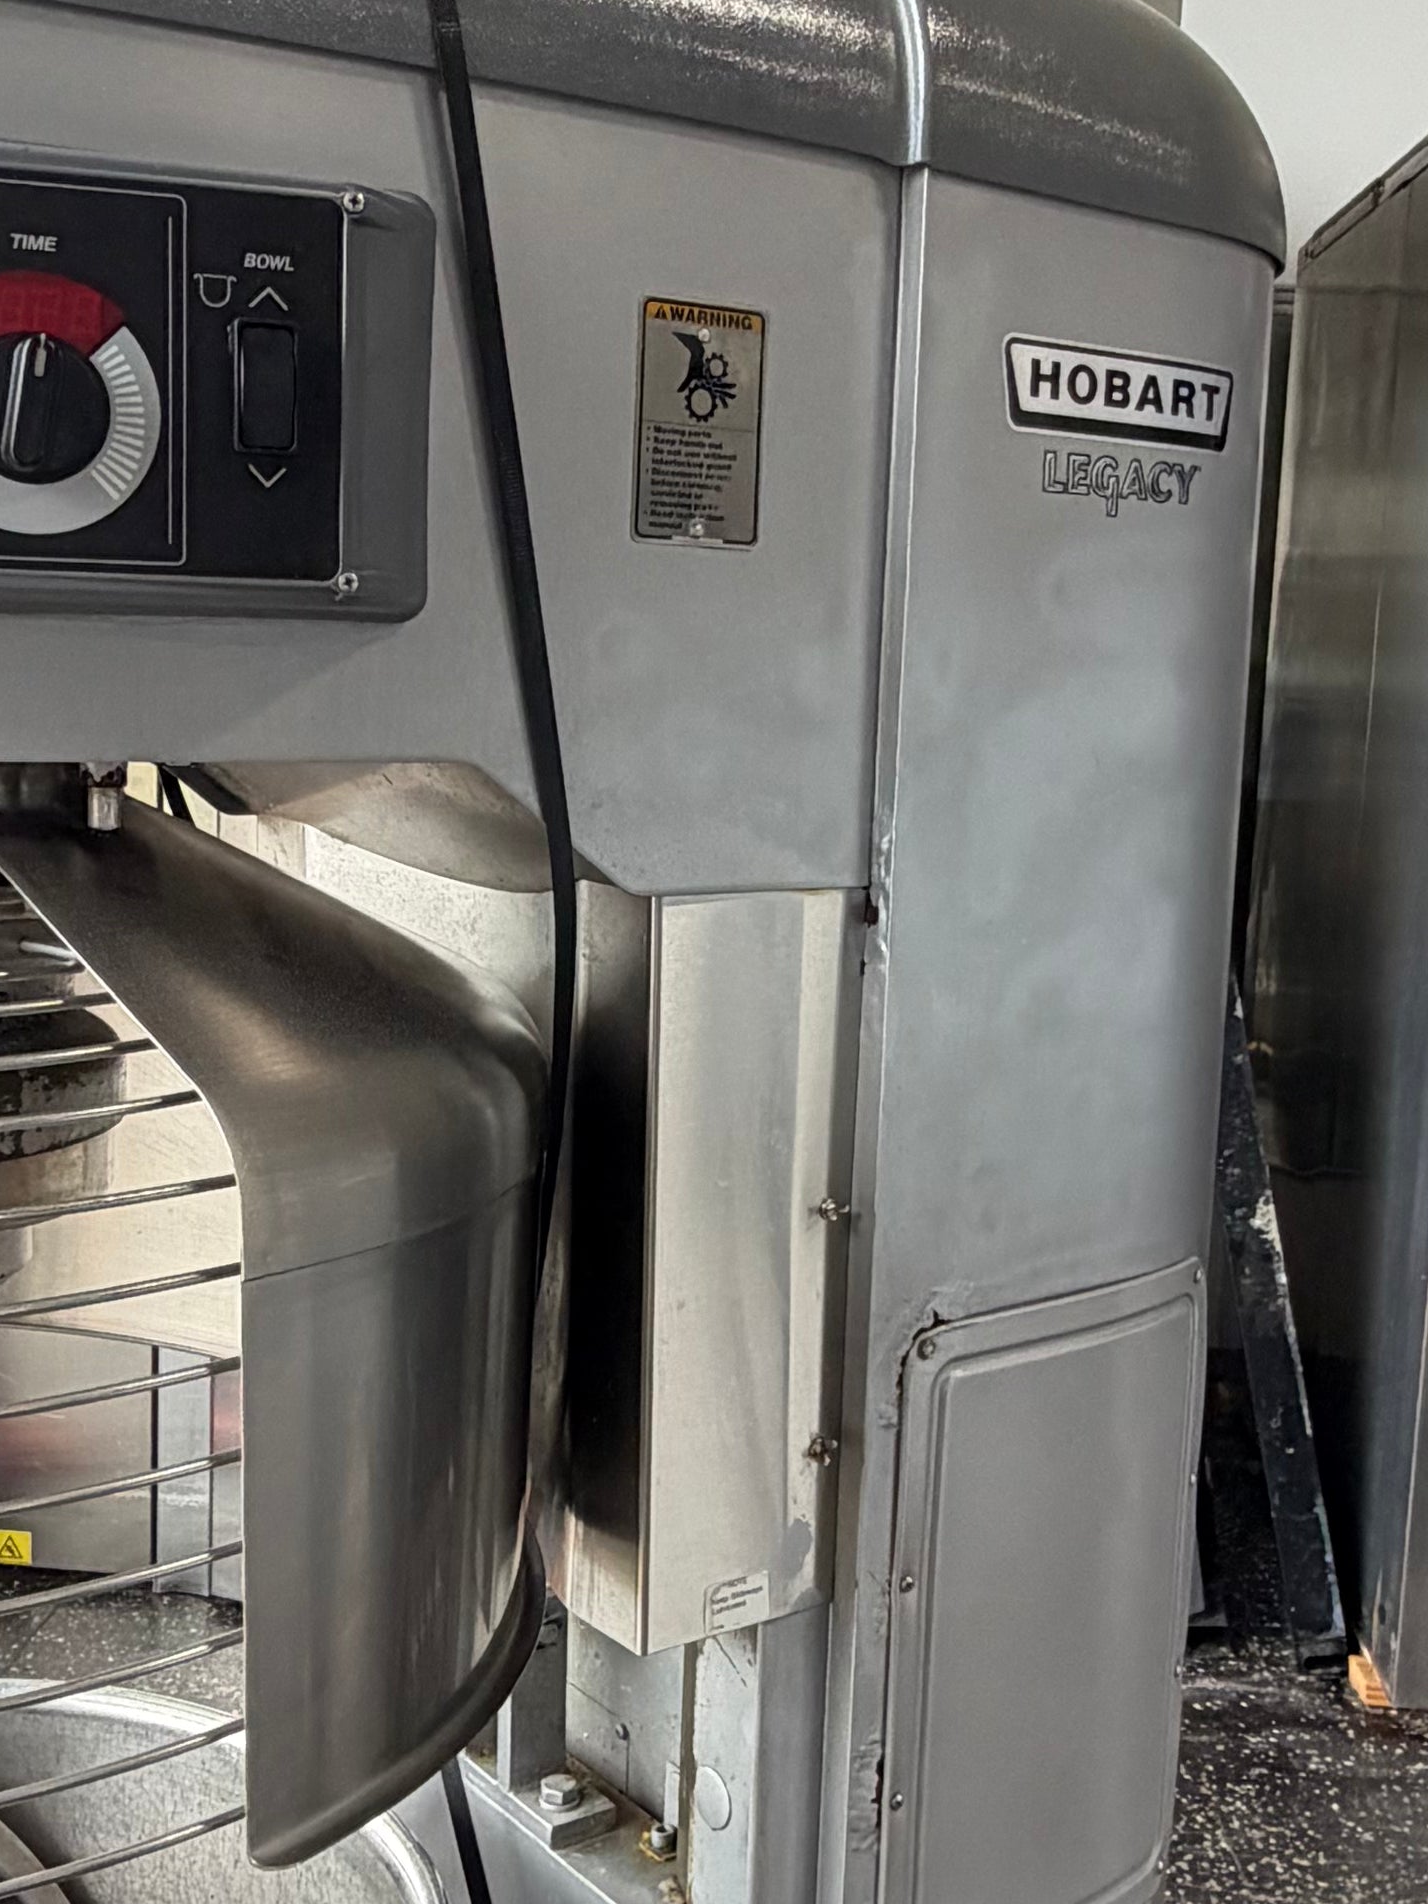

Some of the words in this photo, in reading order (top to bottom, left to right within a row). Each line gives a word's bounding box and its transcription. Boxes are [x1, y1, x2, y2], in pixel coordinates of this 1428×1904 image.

[10, 233, 58, 252] TIME
[244, 252, 294, 272] BOWL
[670, 305, 753, 330] WARNING
[1030, 358, 1220, 421] HOBART
[1042, 450, 1198, 517] LEGACY
